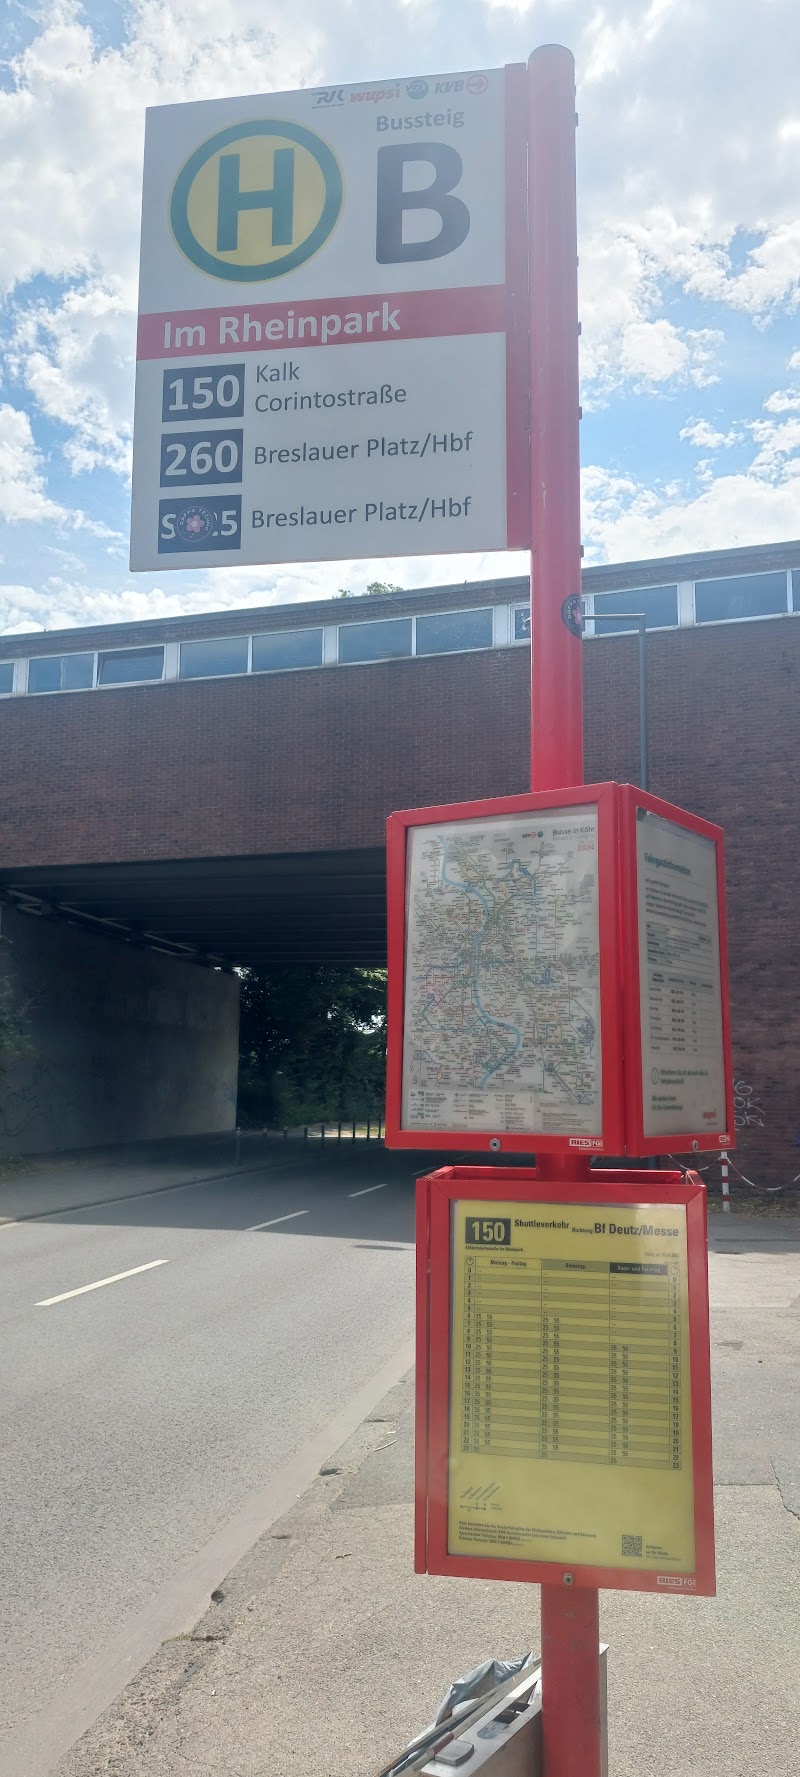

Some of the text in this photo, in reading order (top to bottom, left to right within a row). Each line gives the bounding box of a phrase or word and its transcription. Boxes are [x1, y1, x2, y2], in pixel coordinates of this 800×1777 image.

[351, 84, 399, 104] wupsi
[406, 82, 423, 92] VRS
[434, 80, 464, 94] KVB
[377, 109, 464, 132] Bussteig
[217, 148, 295, 252] H
[376, 142, 470, 264] B
[164, 302, 400, 348] Im Rheinpark
[256, 362, 299, 383] Kalk
[169, 374, 240, 412] 150
[255, 385, 407, 413] Corintostraße
[165, 431, 473, 476] 260 Breslauer Platz/Hbf
[252, 507, 357, 529] Breslauer
[365, 497, 472, 522] Platz/Hbf
[471, 1221, 505, 1242] 150
[514, 1220, 569, 1229] Shuttleverkehr
[594, 1223, 605, 1234] Bf
[609, 1224, 679, 1237] Deutz/Messe
